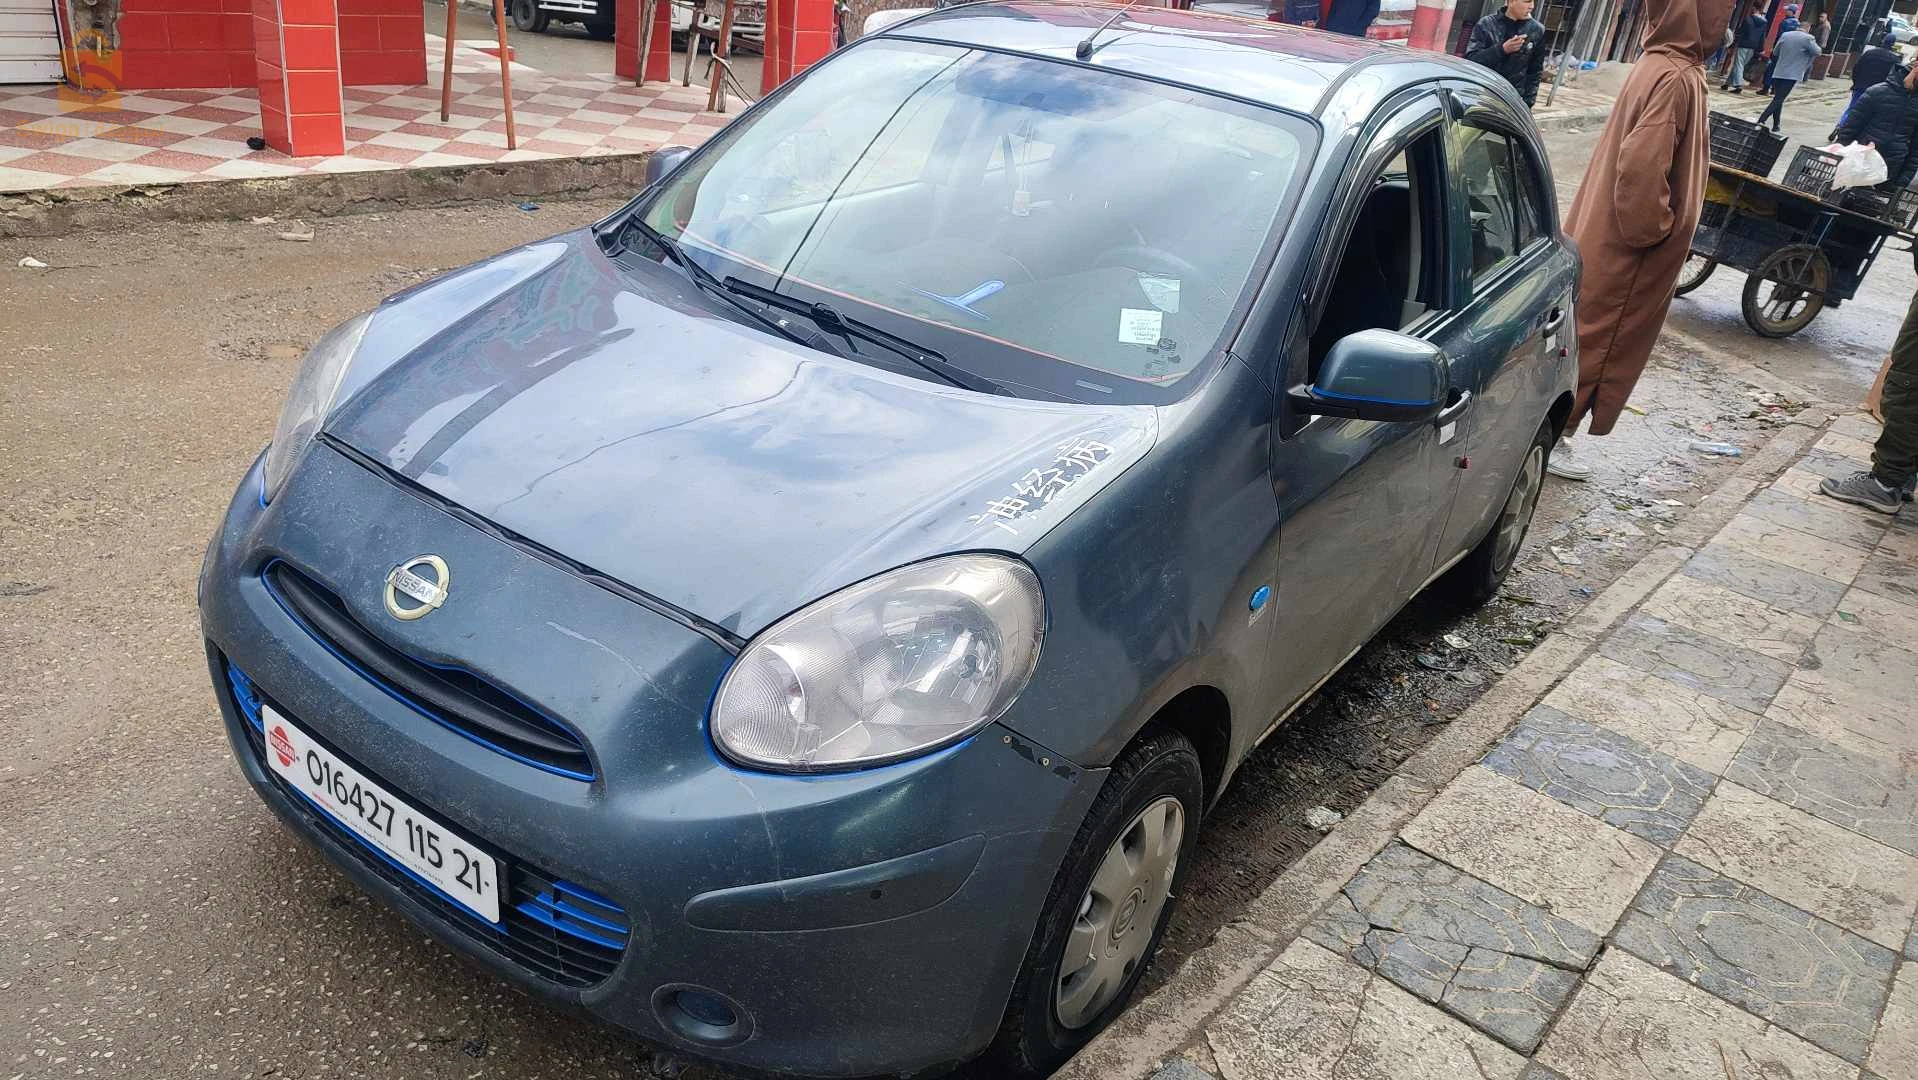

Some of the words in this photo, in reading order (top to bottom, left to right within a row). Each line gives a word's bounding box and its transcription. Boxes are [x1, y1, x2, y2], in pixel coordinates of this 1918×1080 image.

[393, 571, 434, 600] NISSAN
[270, 734, 295, 760] NISSAN
[306, 749, 395, 837] 016427
[405, 817, 443, 869] 115
[453, 848, 482, 895] 21
